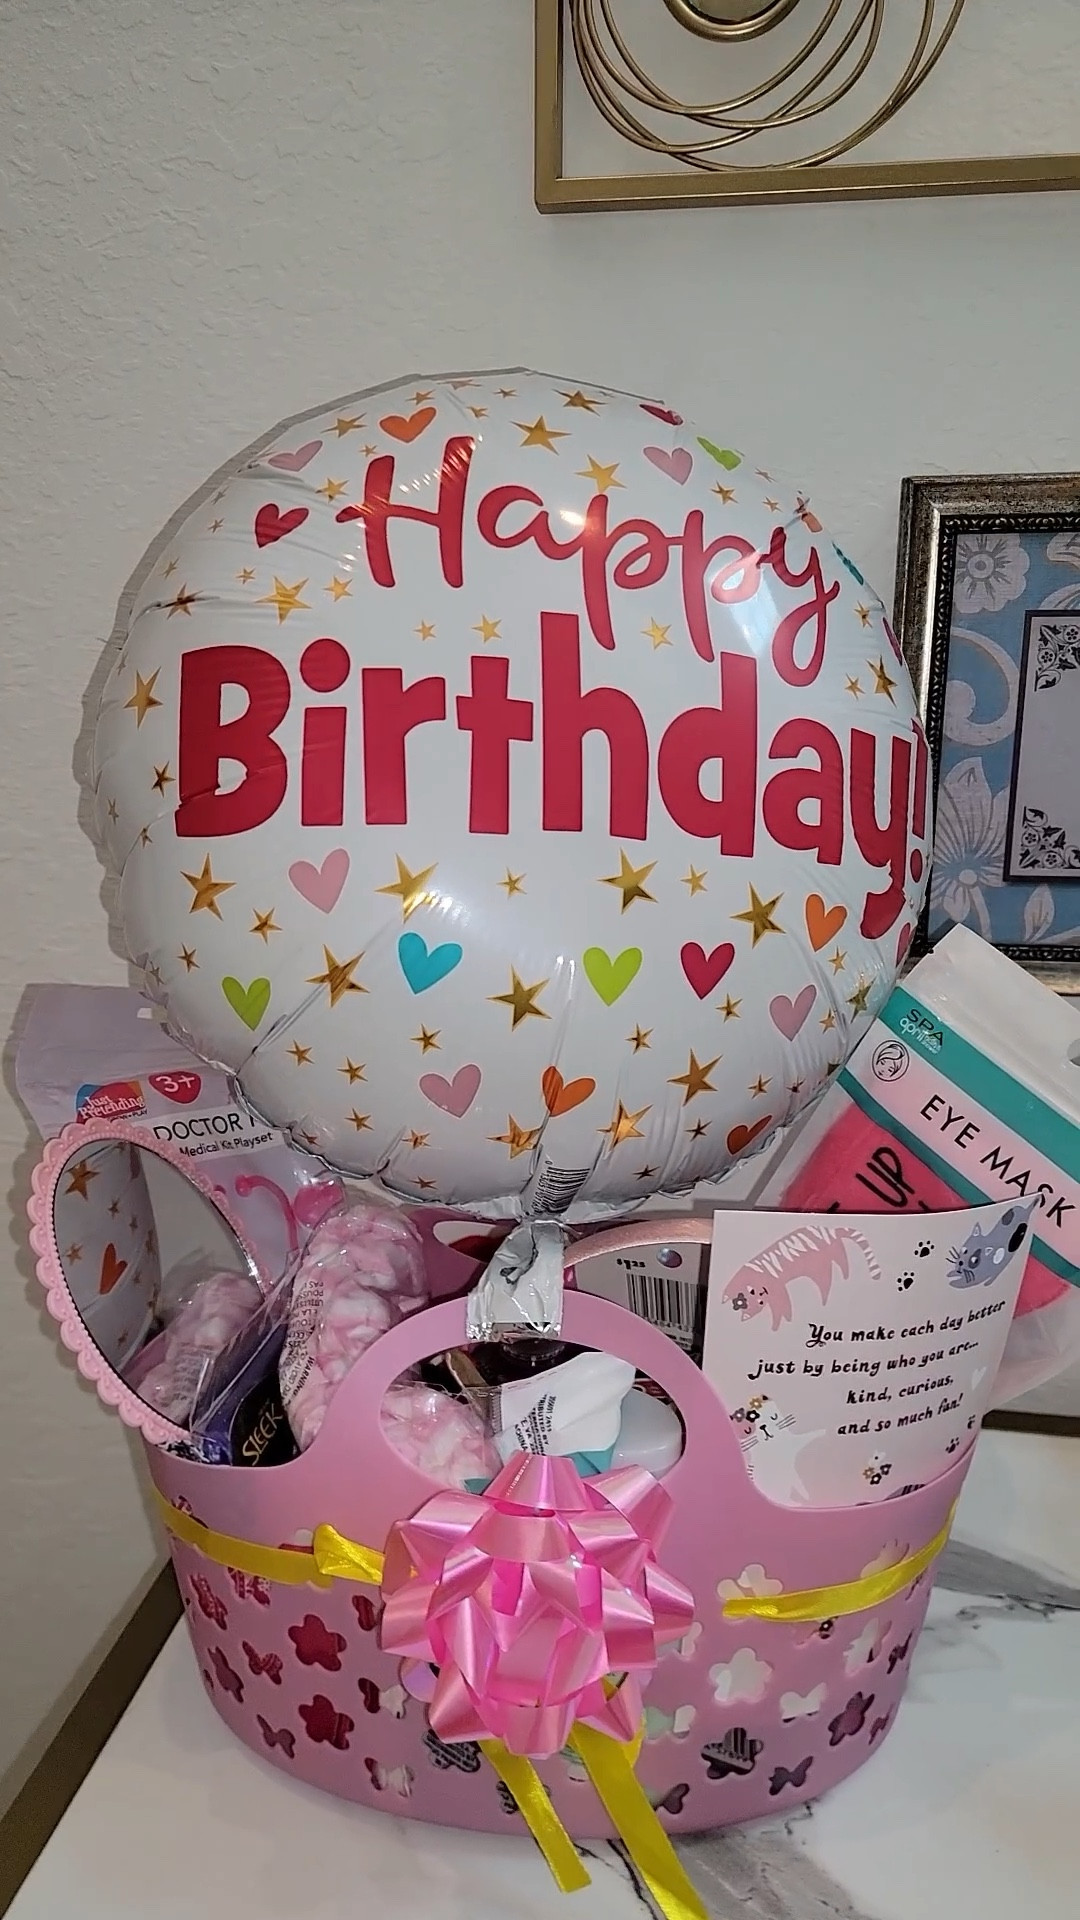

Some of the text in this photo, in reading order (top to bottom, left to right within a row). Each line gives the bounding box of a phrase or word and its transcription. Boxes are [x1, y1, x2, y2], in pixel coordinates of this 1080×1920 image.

[336, 436, 841, 687] Happy
[174, 612, 928, 942] Birthday!
[906, 1008, 943, 1046] SPA
[85, 1094, 112, 1110] Just
[155, 1074, 196, 1093] 3+
[78, 1095, 145, 1119] Pretending
[153, 1112, 243, 1142] DOCTOR
[179, 1141, 219, 1158] Medical
[234, 1132, 273, 1149] Playset
[855, 1147, 915, 1207] UP
[919, 1094, 1076, 1228] EYE MASK
[805, 1300, 1006, 1348] You make each day better
[747, 1341, 979, 1380] just by being who you are...
[837, 1392, 964, 1435] and so much fun!
[846, 1387, 892, 1404] kind,
[242, 1403, 284, 1467] SLEEK
